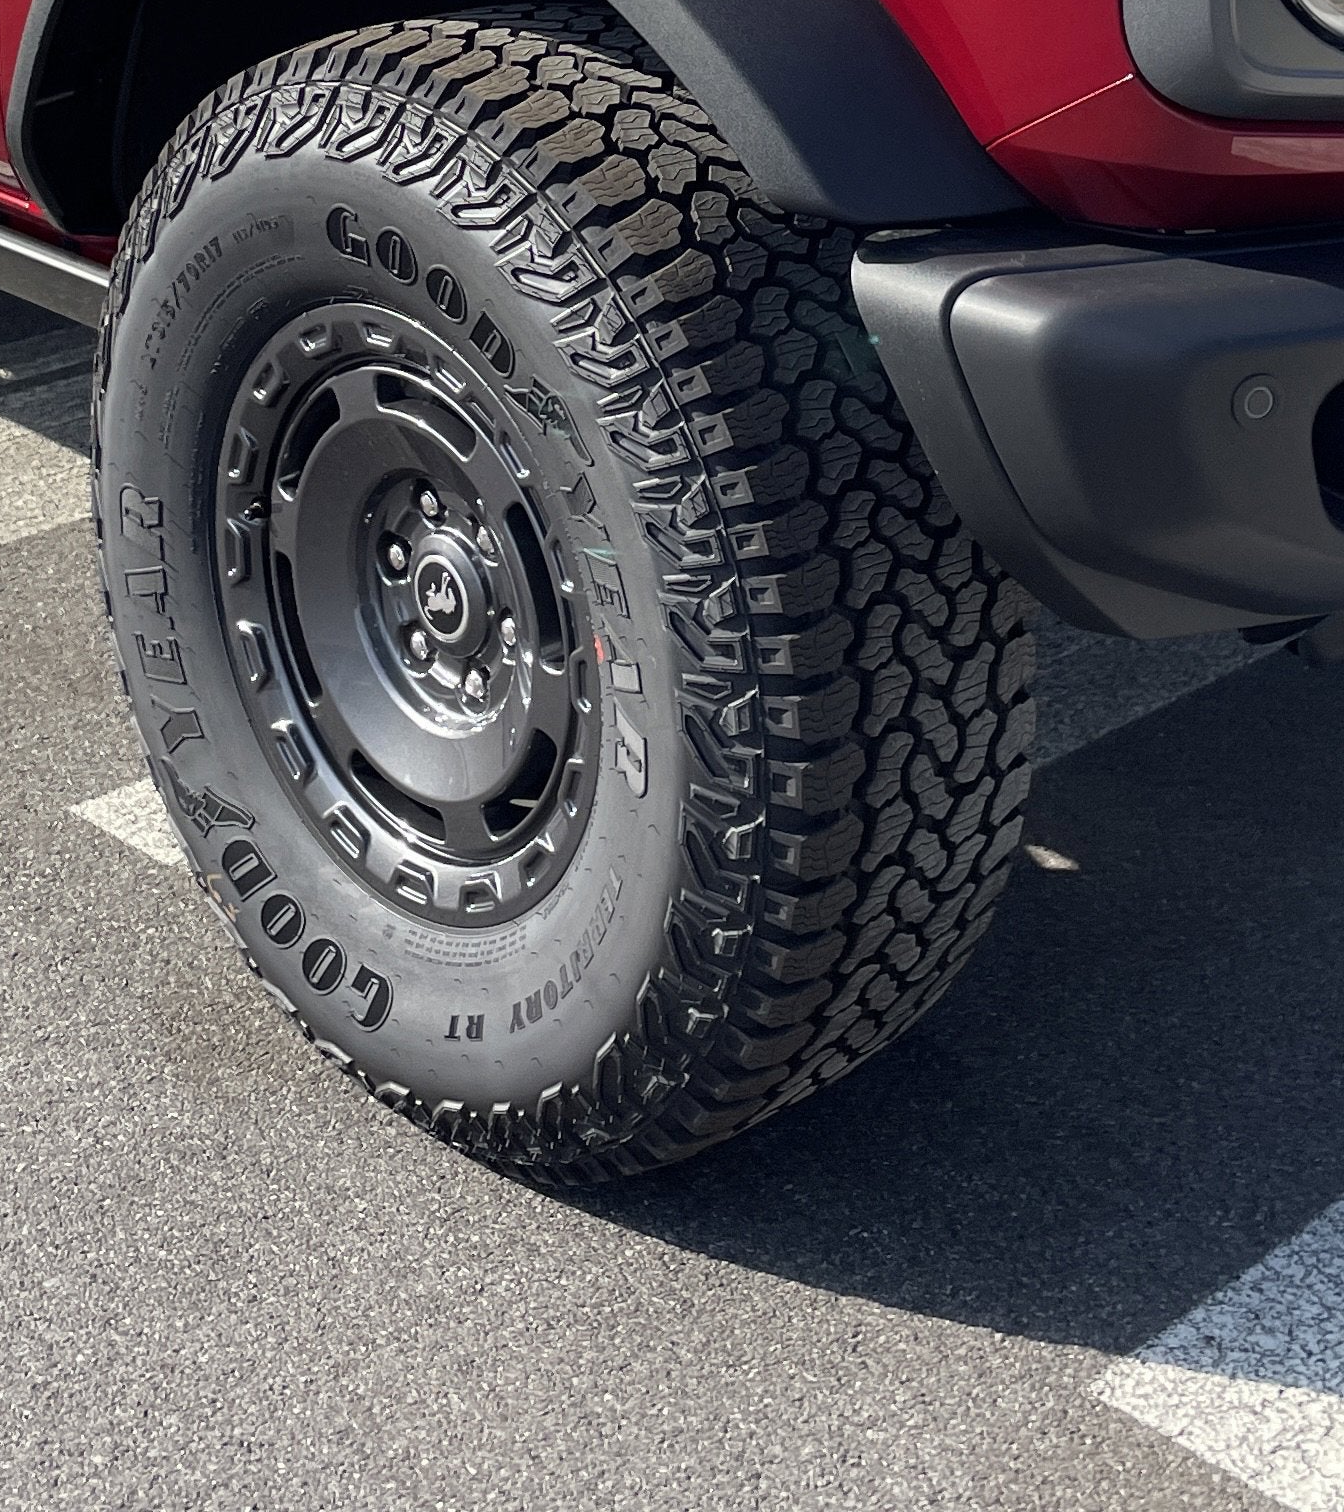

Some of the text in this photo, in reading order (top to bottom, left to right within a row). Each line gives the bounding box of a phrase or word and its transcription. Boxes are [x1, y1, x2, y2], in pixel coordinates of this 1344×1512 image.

[325, 202, 649, 800] GOODYEAR
[118, 481, 394, 1033] GOODYEAR
[443, 1013, 486, 1042] RT
[509, 866, 624, 1034] TERRITORY
